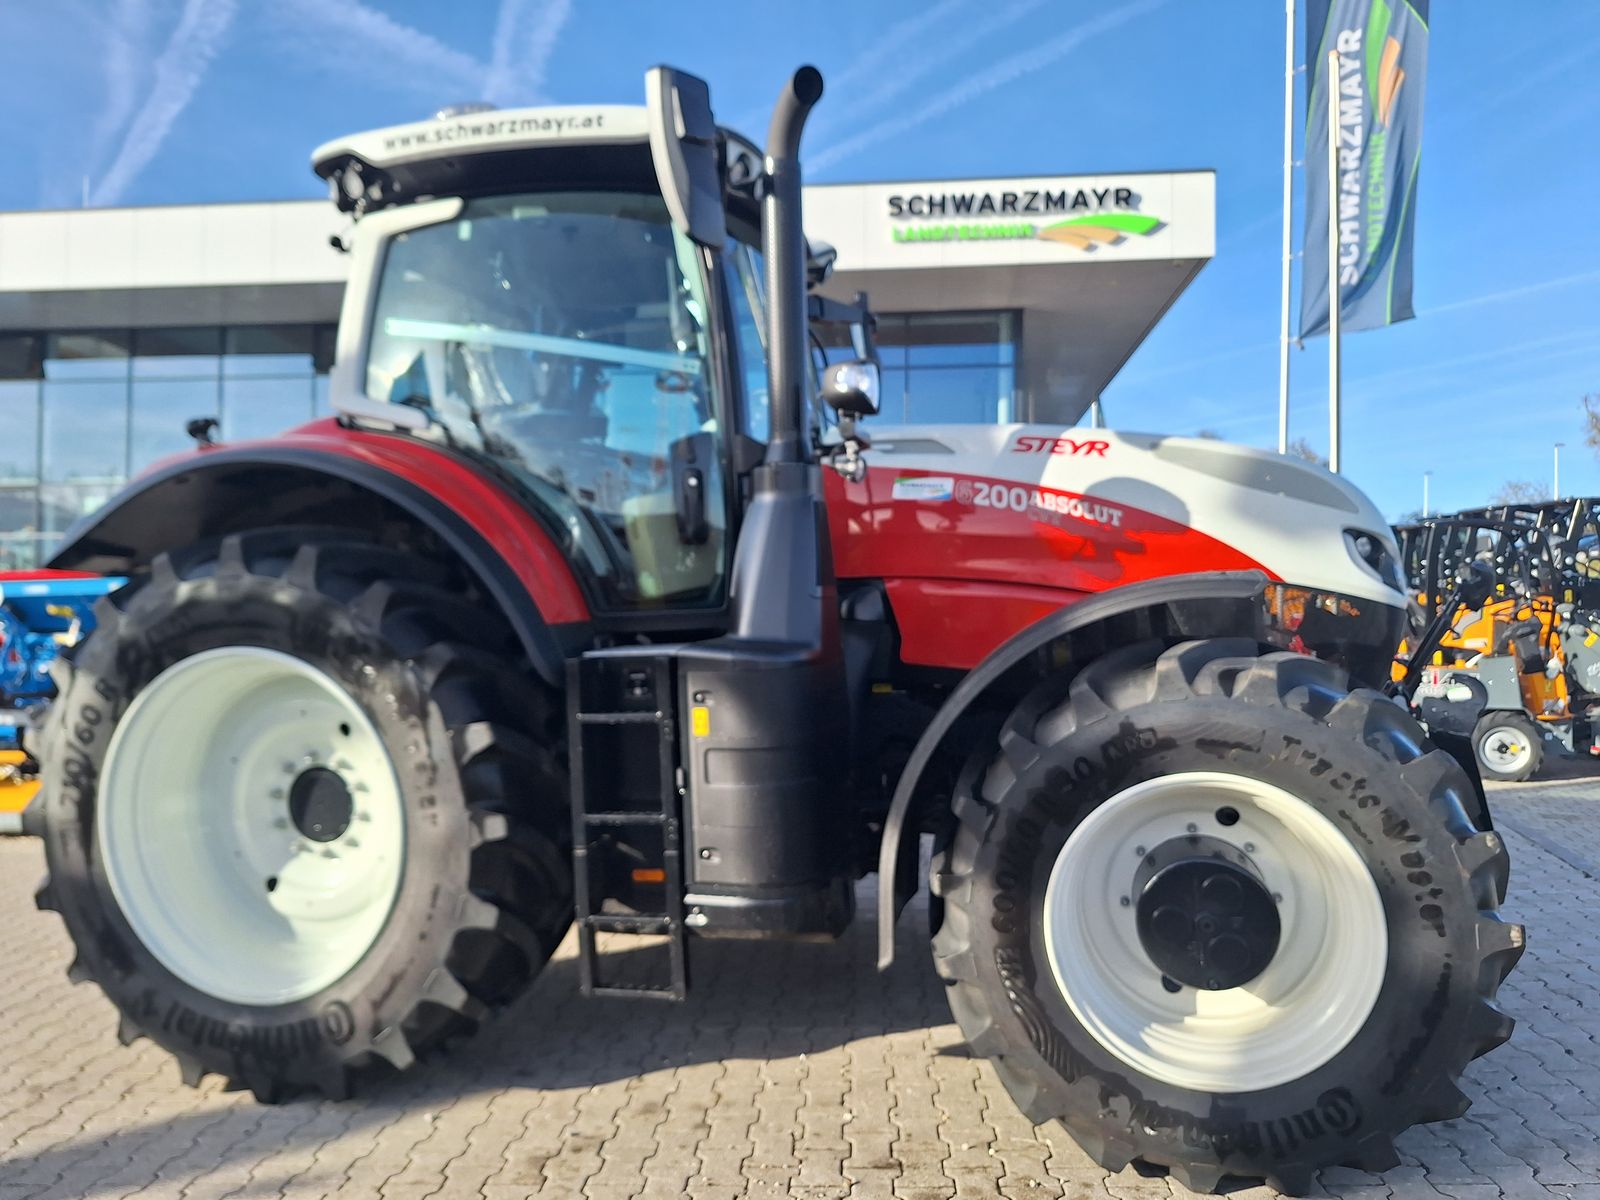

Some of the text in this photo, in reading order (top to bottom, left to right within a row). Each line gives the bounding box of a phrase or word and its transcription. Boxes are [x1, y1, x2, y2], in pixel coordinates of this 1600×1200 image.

[384, 114, 605, 150] www.schwarzmayr.at
[1337, 29, 1363, 286] SCHWARZMAYR
[888, 187, 1133, 217] SCHWARZMAYR
[1365, 131, 1387, 276] NDTECHNIK
[1012, 436, 1110, 458] STEYR
[955, 480, 1123, 527] 6200 ABSOLUT
